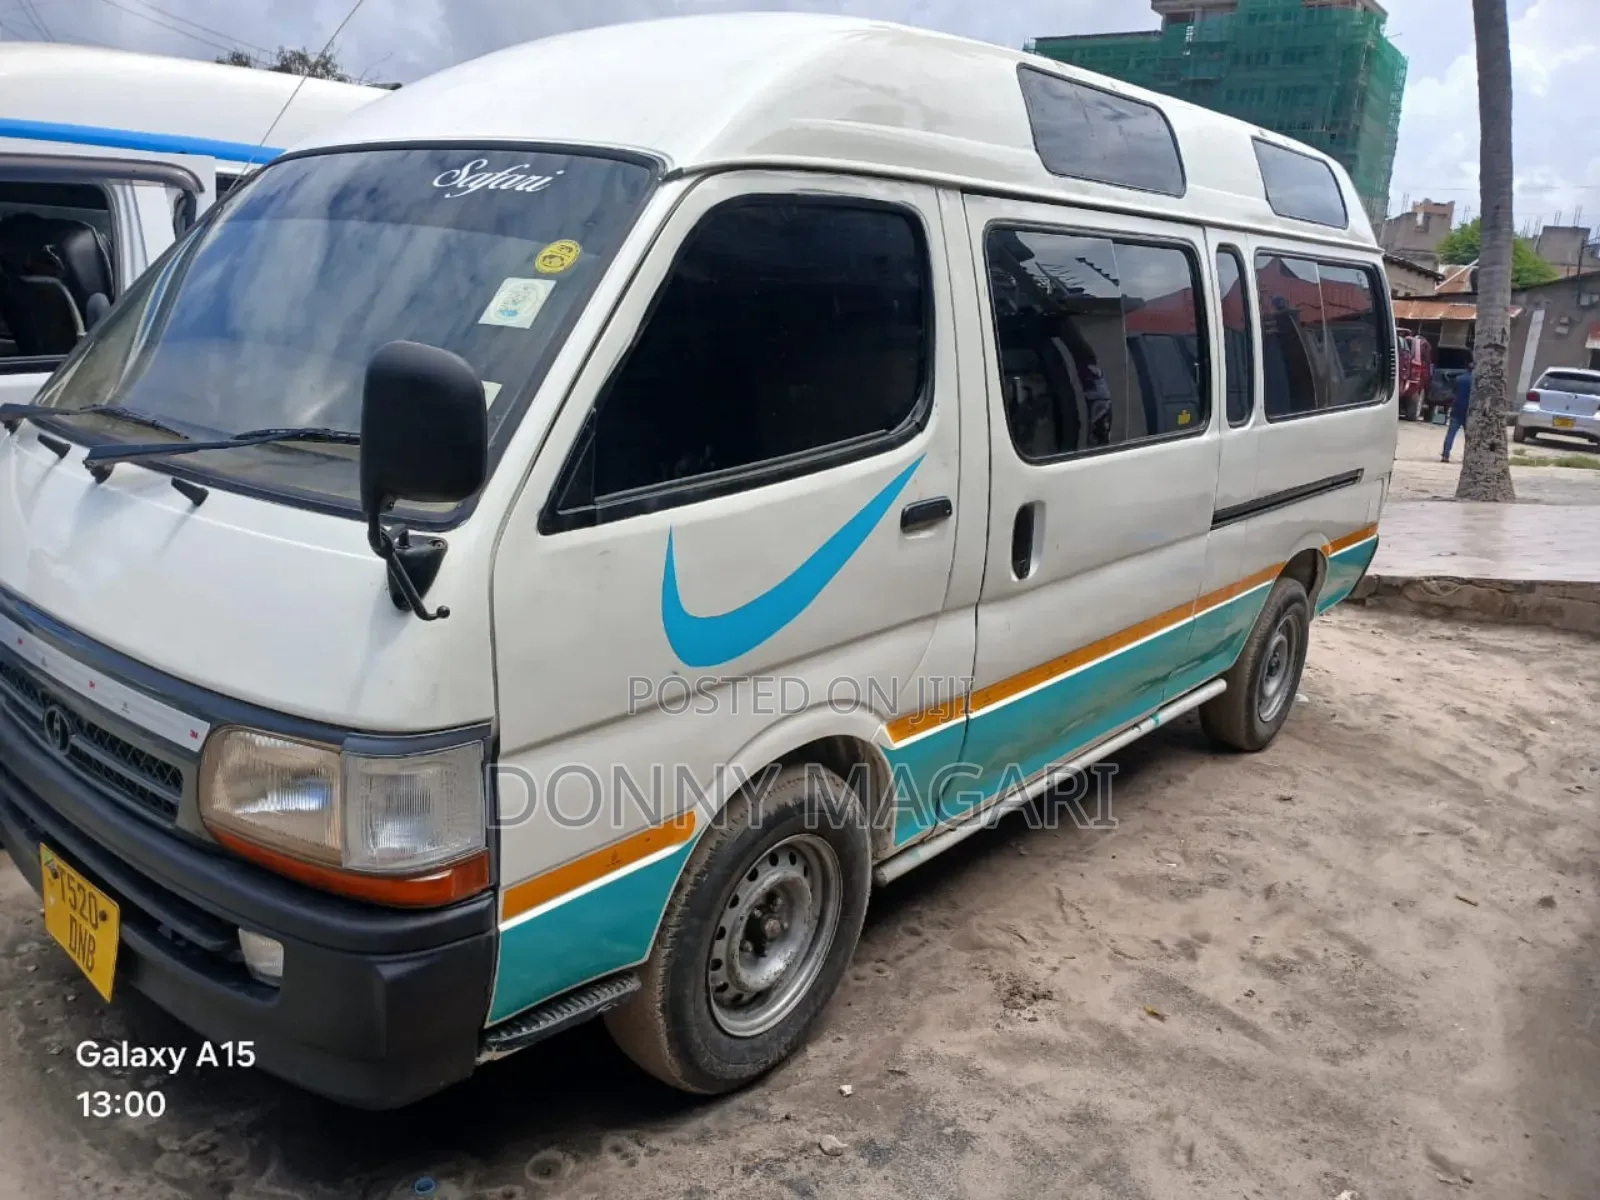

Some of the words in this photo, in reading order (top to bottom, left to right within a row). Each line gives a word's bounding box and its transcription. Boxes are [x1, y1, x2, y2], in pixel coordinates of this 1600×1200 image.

[433, 159, 565, 198] Safari
[57, 864, 99, 931] T520
[69, 913, 97, 973] DNB
